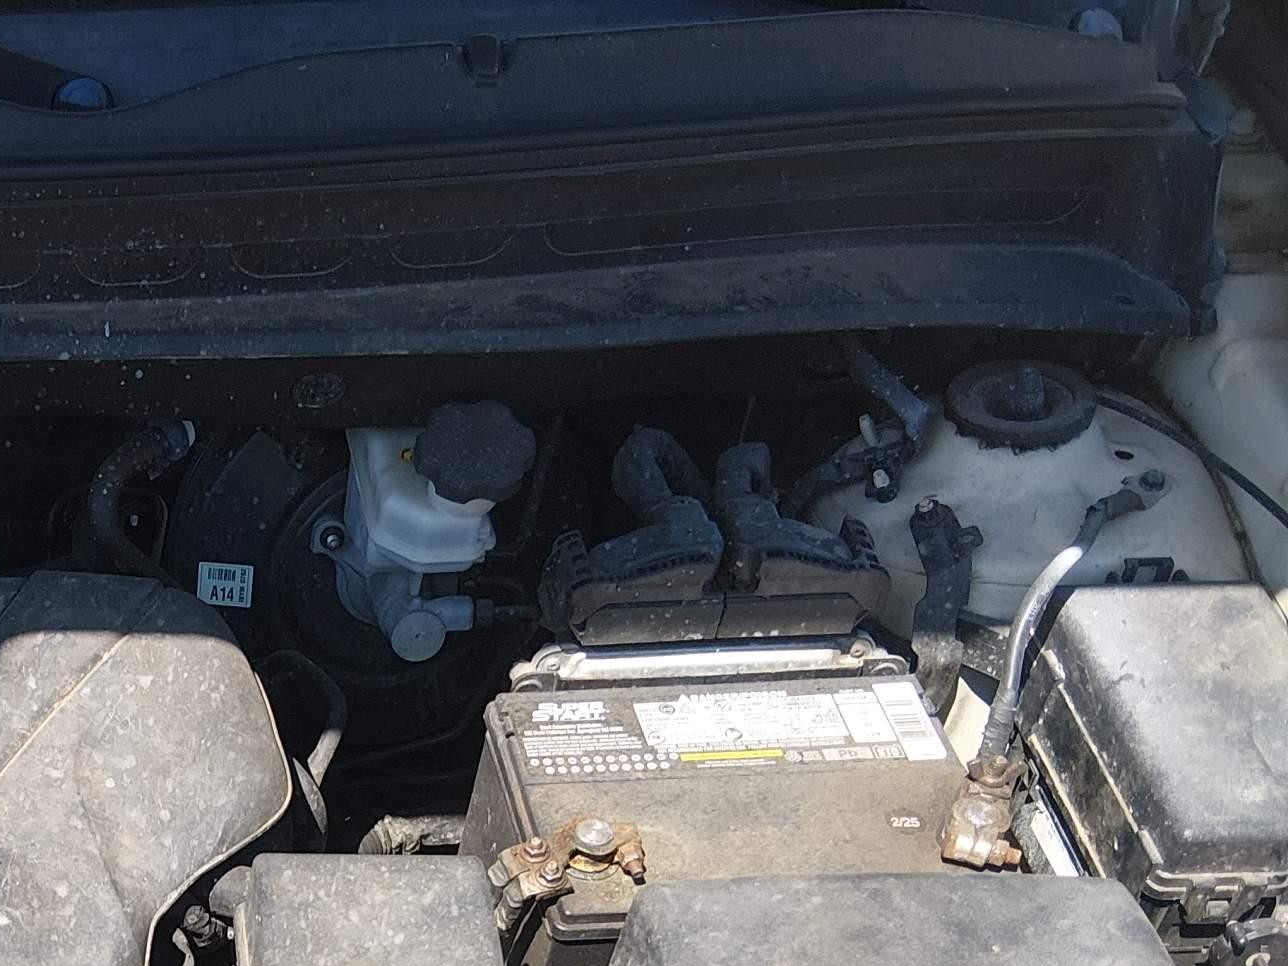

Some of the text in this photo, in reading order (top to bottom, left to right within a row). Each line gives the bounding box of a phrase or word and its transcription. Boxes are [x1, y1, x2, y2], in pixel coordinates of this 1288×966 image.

[210, 585, 234, 601] A14
[538, 701, 603, 713] SUPER
[532, 710, 602, 722] START
[890, 816, 921, 828] 2/25
